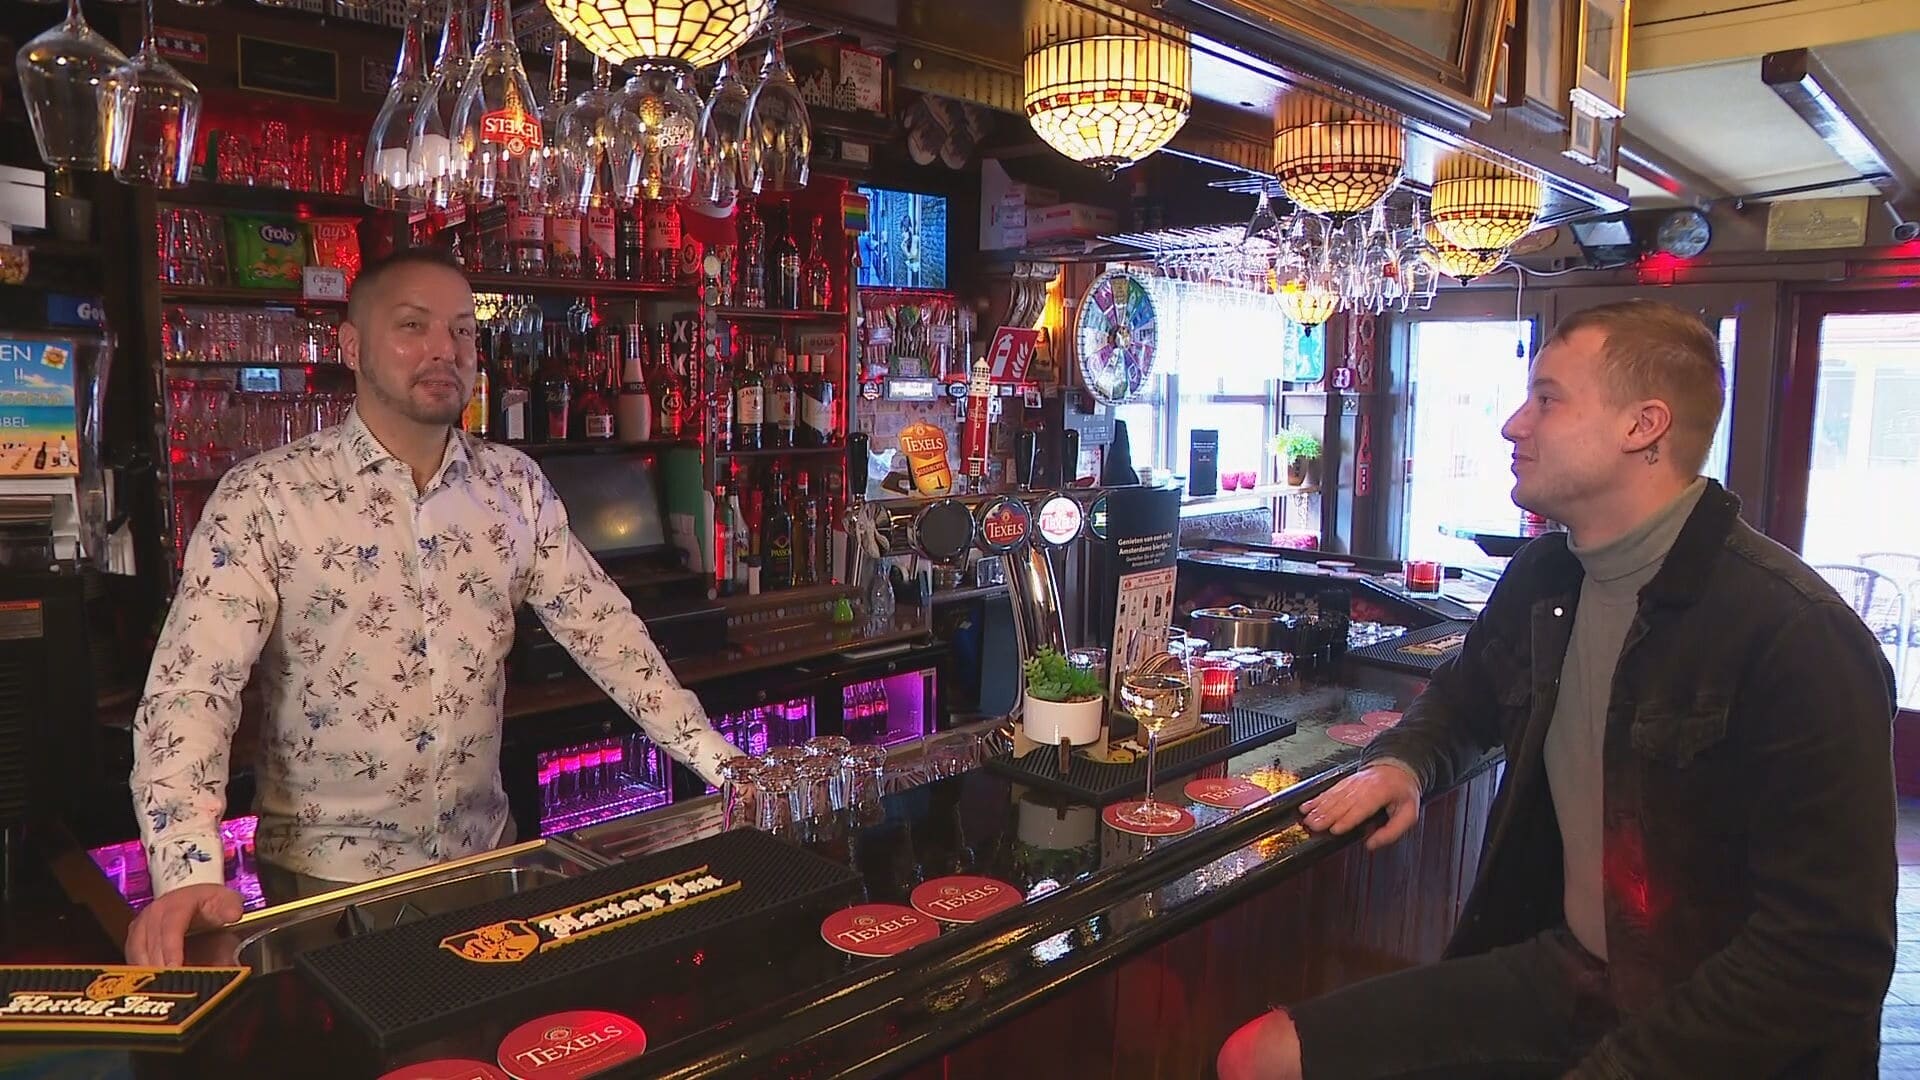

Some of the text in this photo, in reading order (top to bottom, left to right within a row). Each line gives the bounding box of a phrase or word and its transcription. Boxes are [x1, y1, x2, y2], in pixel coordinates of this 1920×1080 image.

[485, 117, 541, 146] TEXELS
[261, 225, 296, 242] Croky
[0, 417, 30, 428] BEL
[901, 436, 944, 453] TEXELS
[987, 522, 1024, 540] TEXELS
[1200, 784, 1253, 801] TEXELS
[538, 874, 723, 939] Hertog Jan
[928, 884, 1000, 912] TEXELS
[837, 914, 918, 944] TEXELS
[0, 995, 175, 1017] Hertog Jan
[516, 1025, 623, 1067] TEXELS
